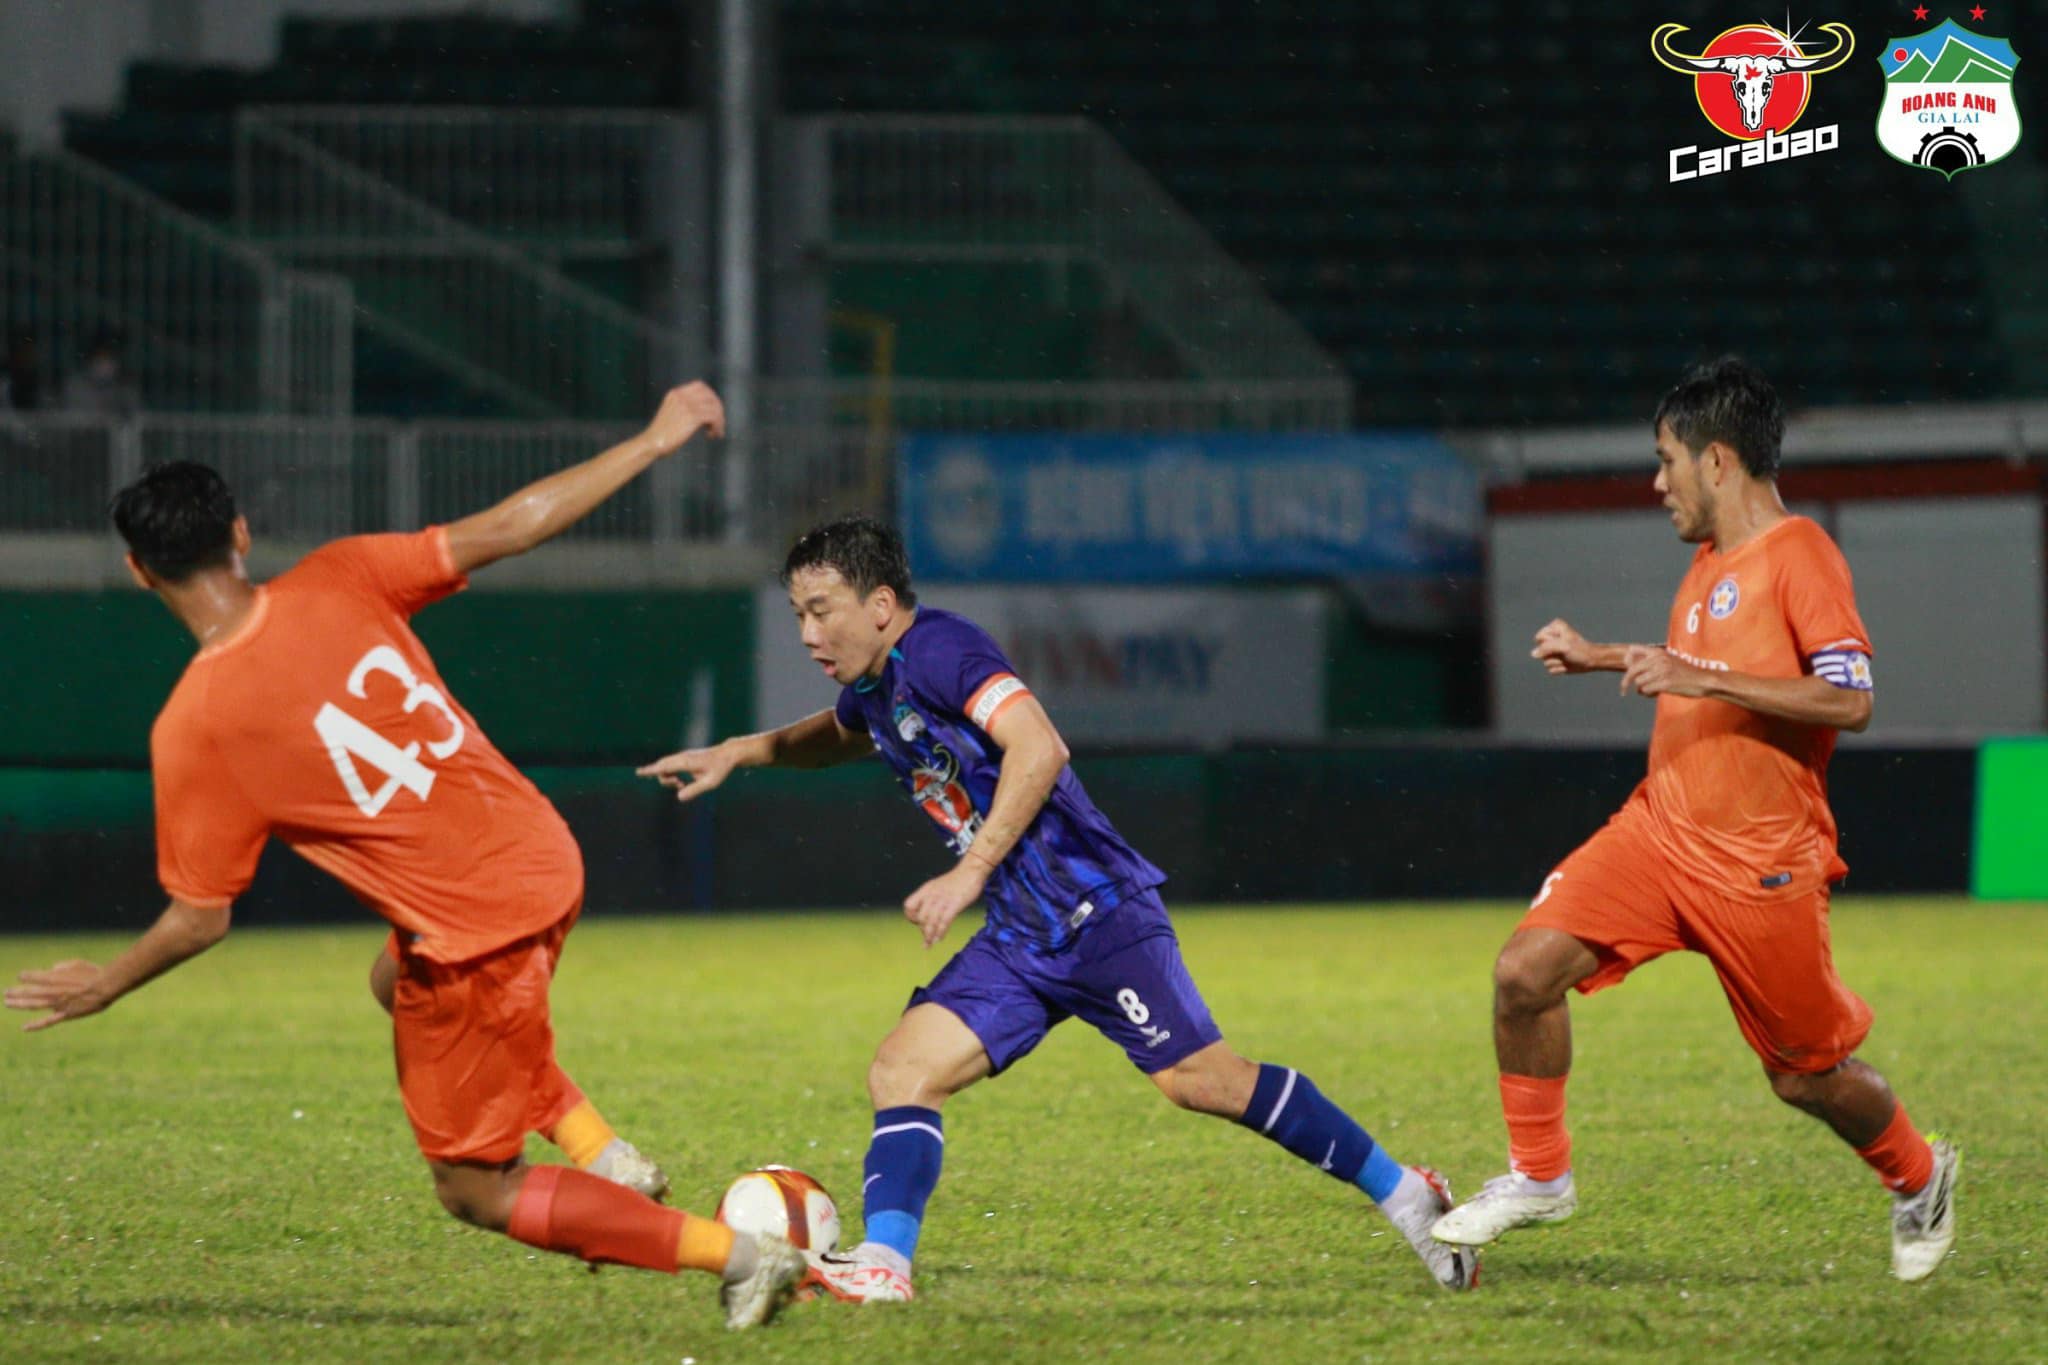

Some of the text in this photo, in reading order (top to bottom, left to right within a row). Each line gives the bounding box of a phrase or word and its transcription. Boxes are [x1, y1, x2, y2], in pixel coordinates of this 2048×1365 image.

[1687, 602, 1702, 634] 6
[313, 645, 464, 817] 43
[1117, 988, 1149, 1024] 8
